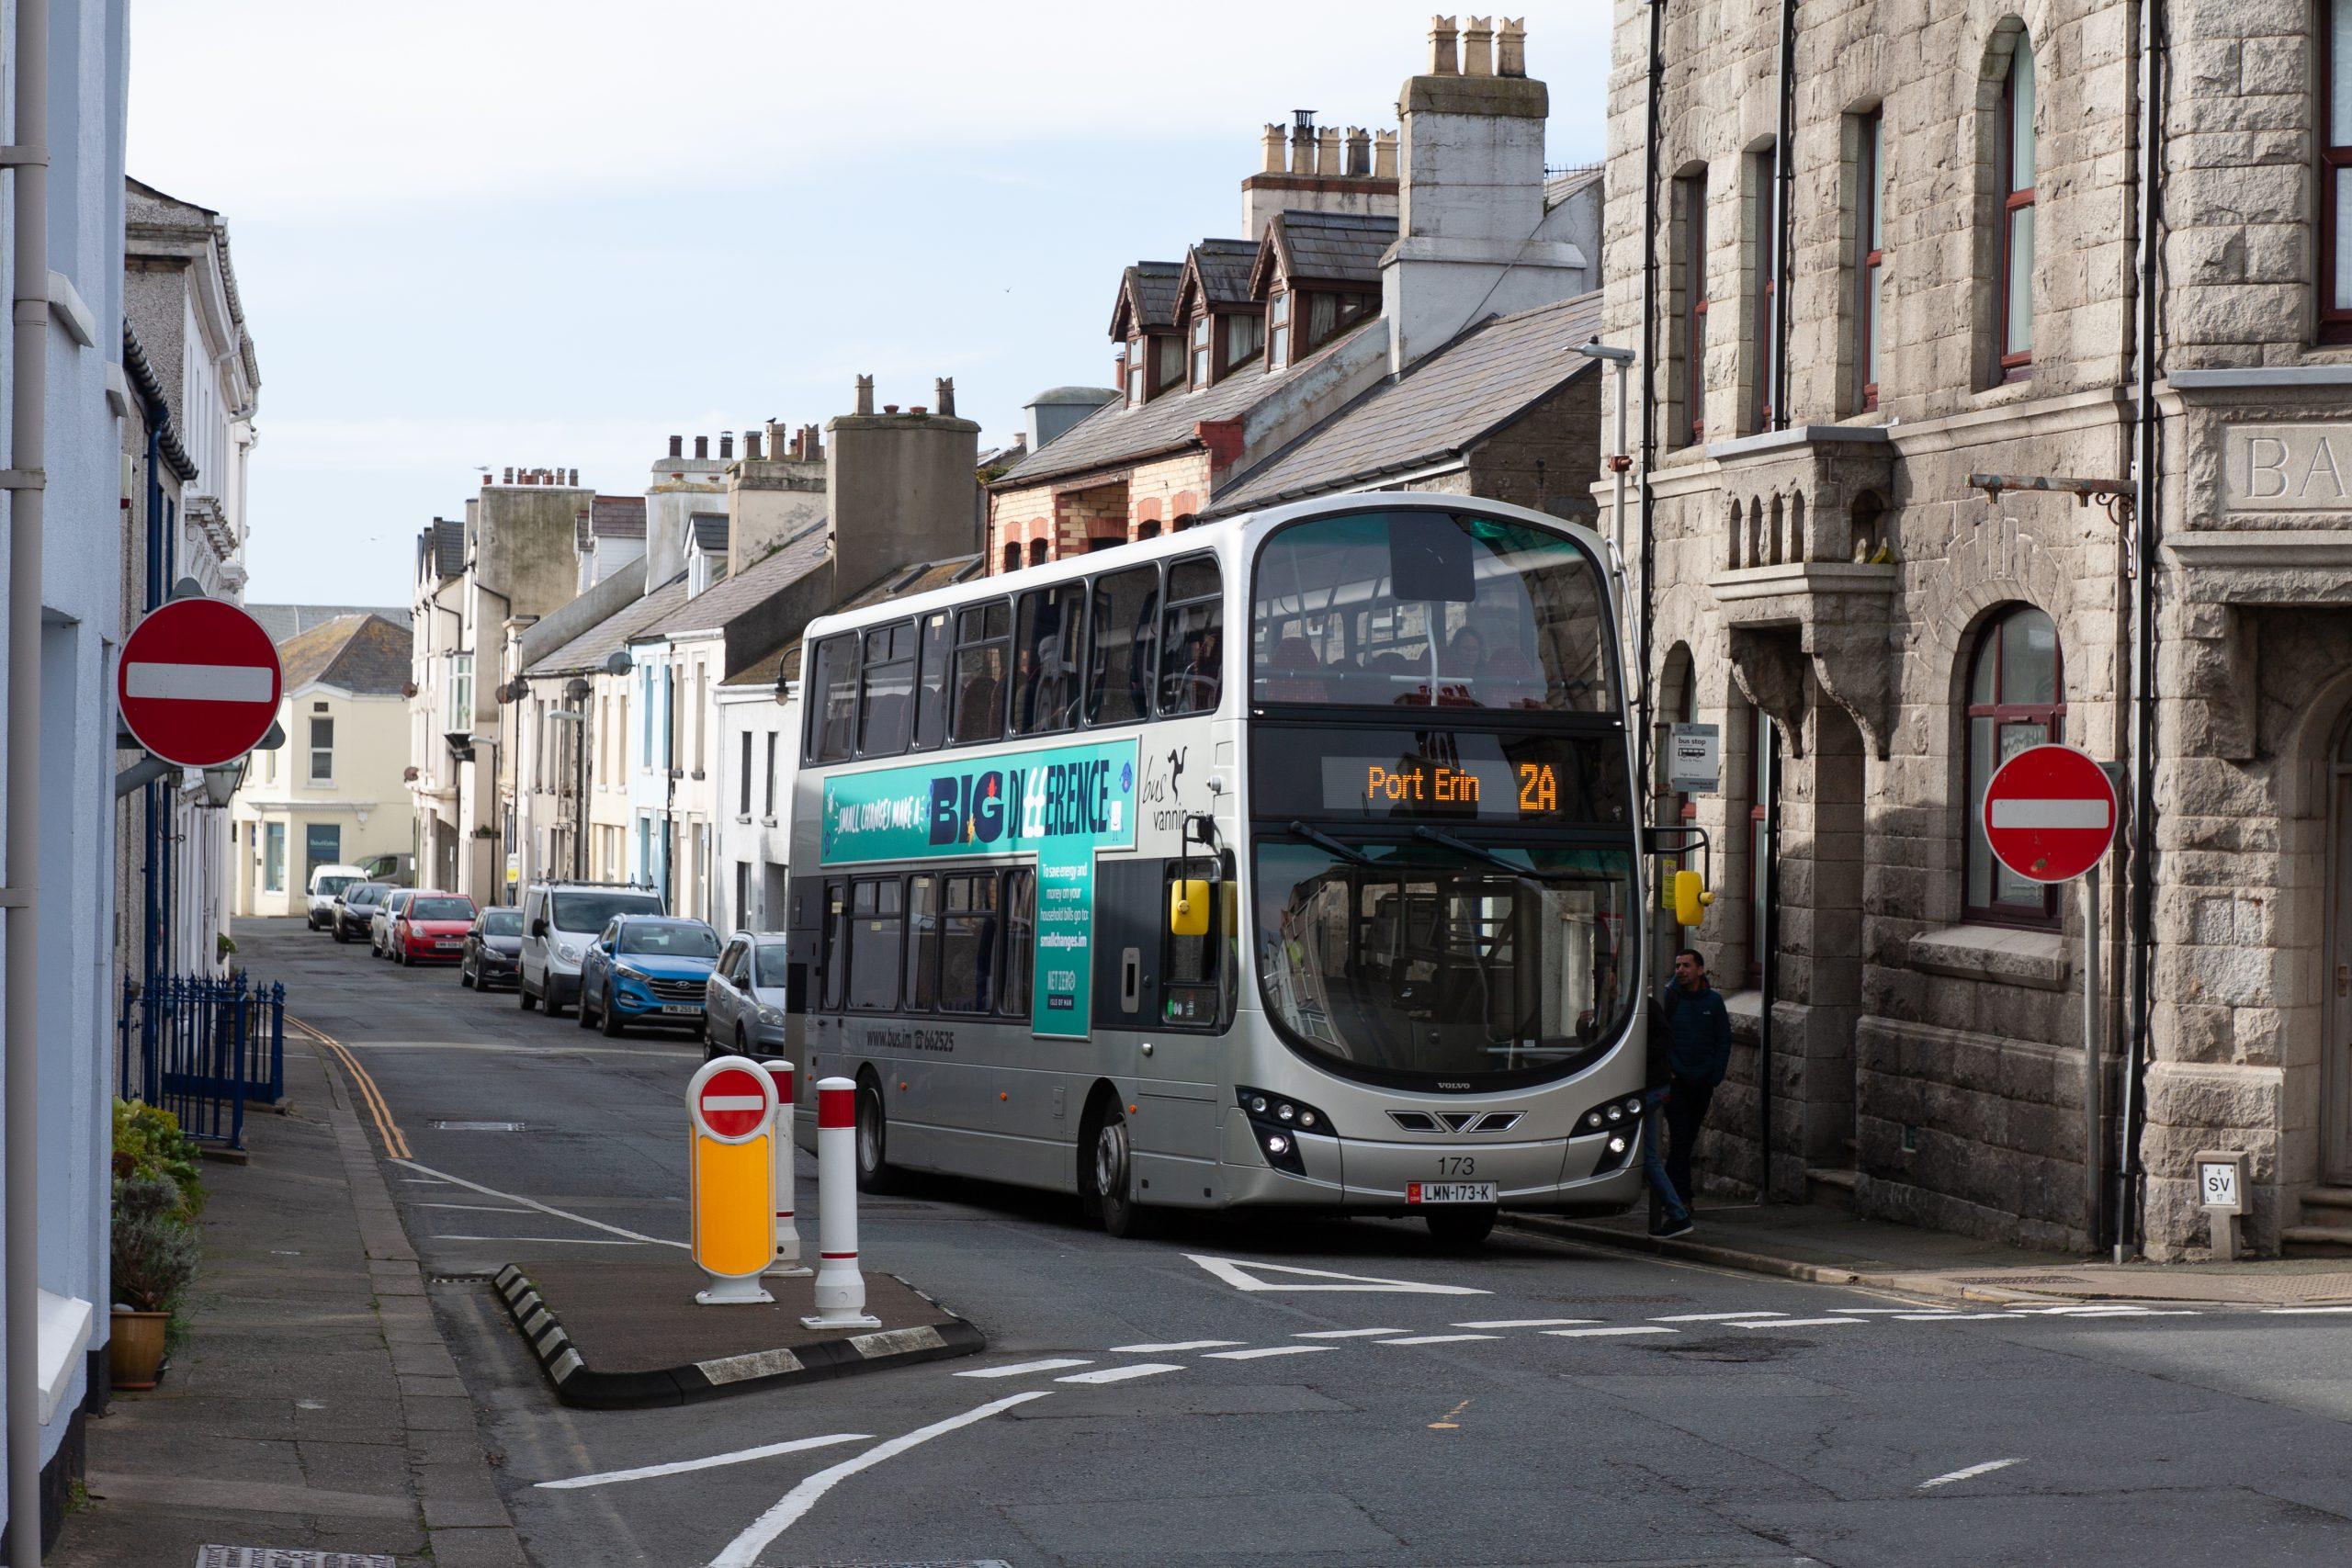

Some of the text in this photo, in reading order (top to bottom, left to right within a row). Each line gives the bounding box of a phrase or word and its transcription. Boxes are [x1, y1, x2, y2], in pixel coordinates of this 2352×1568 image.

[1679, 737, 1706, 747] bus stop
[1142, 755, 1168, 805] bus
[1369, 766, 1480, 801] Port Erin
[1520, 763, 1556, 810] 2A
[838, 803, 860, 834] SMALL
[861, 798, 891, 832] CHANGES
[891, 795, 913, 830] MAKE
[929, 771, 1004, 846] BIG
[1042, 862, 1088, 881] To save energy and
[1046, 887, 1081, 902] money on your
[1040, 908, 1063, 921] household
[1064, 907, 1073, 921] bills
[1074, 910, 1081, 925] go
[1040, 931, 1087, 952] smallchanges.im
[1047, 970, 1075, 991] NET ZERO
[1064, 998, 1072, 1007] MAN
[866, 1026, 955, 1053] www.bus.im 662525
[1438, 1156, 1475, 1175] 173
[1425, 1185, 1488, 1201] LMN-173-K
[2209, 1177, 2230, 1191] SV
